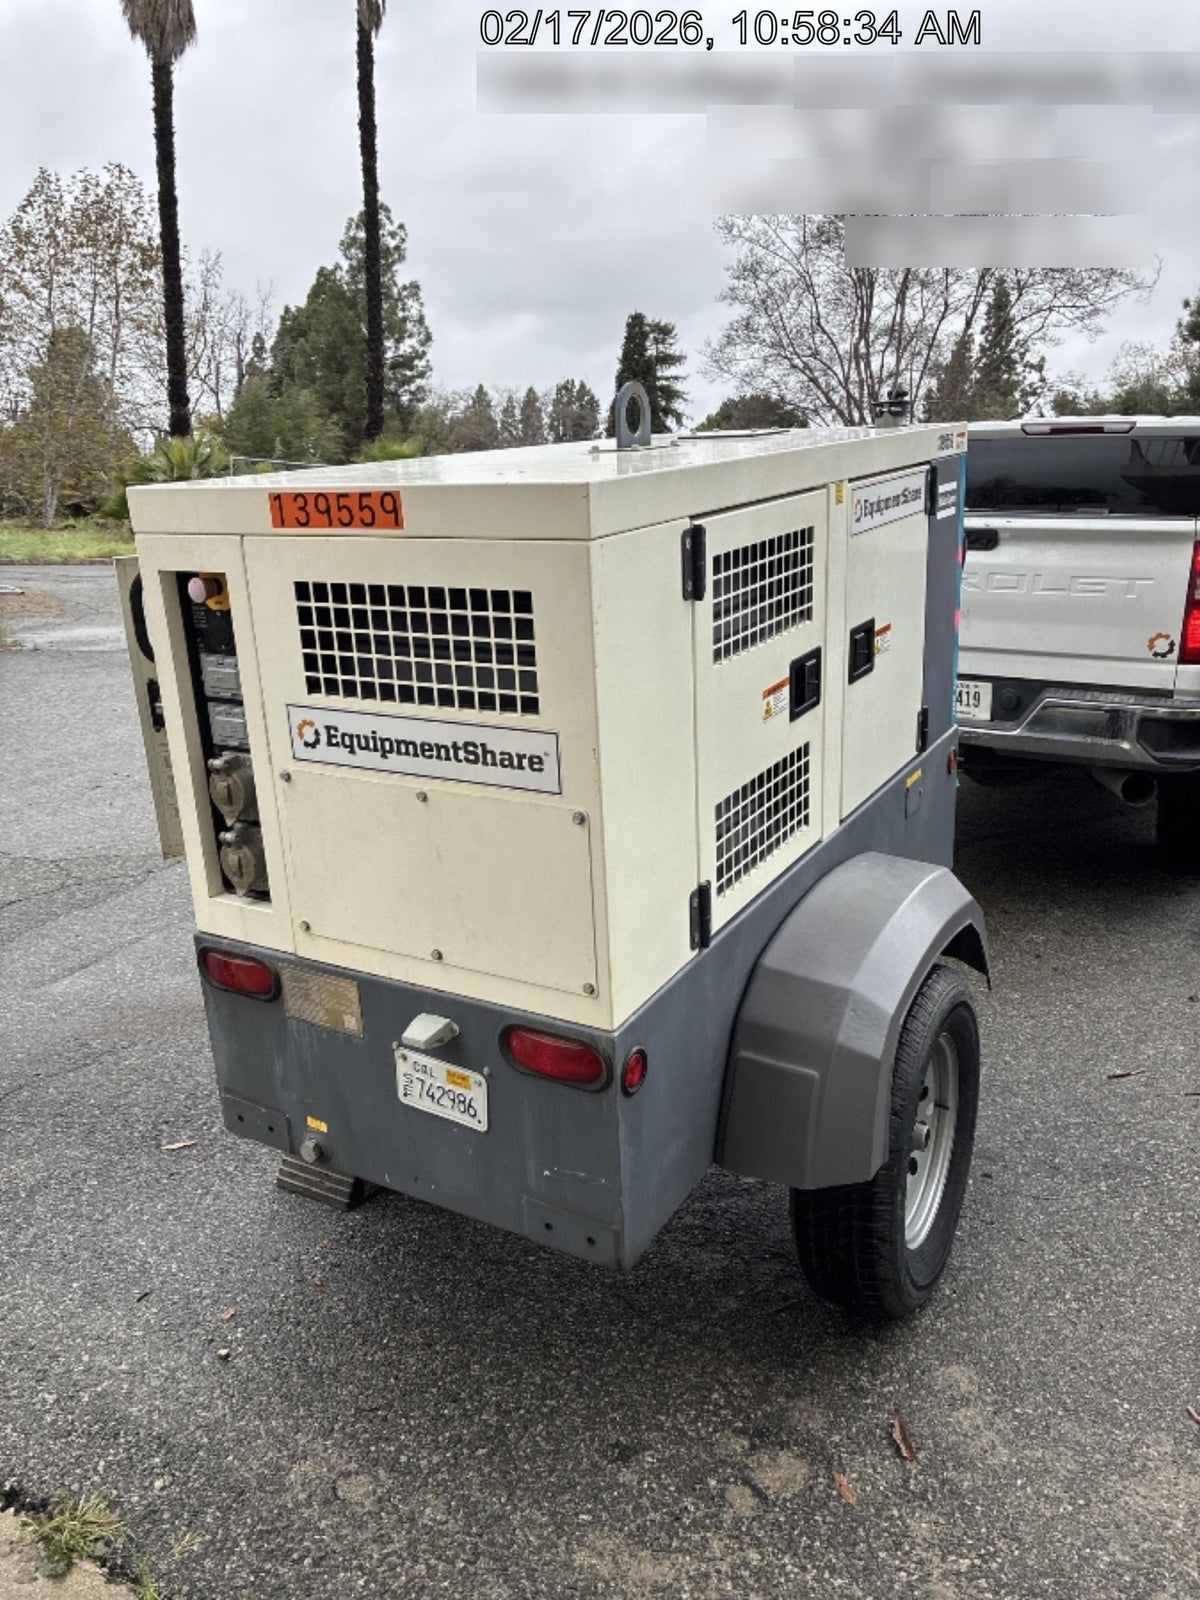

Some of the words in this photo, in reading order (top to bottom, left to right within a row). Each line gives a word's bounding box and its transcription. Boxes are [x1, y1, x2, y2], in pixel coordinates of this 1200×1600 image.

[273, 491, 400, 528] 139559
[324, 725, 545, 773] EquipmentShare
[413, 1060, 436, 1079] CAL
[416, 1076, 477, 1118] 742986
